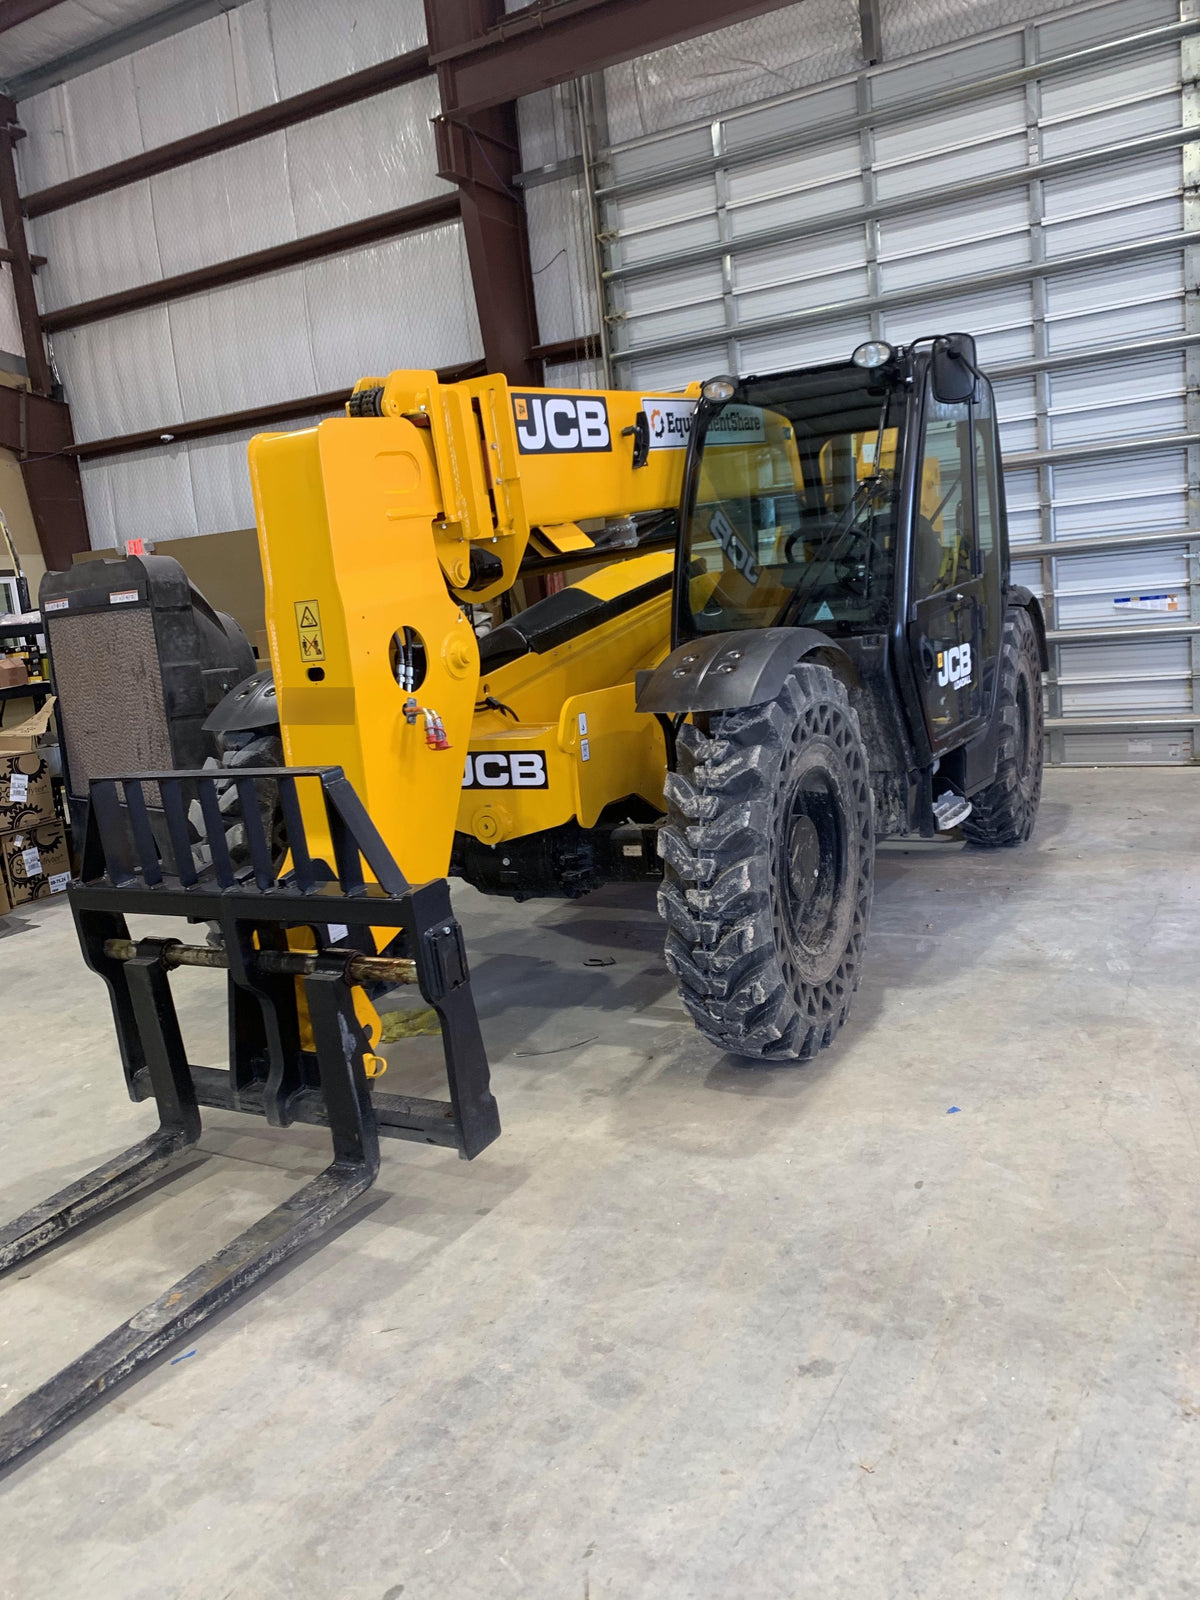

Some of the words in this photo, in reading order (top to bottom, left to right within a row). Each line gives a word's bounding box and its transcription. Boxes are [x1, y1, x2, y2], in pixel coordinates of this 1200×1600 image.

[517, 398, 610, 450] JCB
[665, 411, 761, 438] EquientShare
[938, 642, 972, 687] JCB
